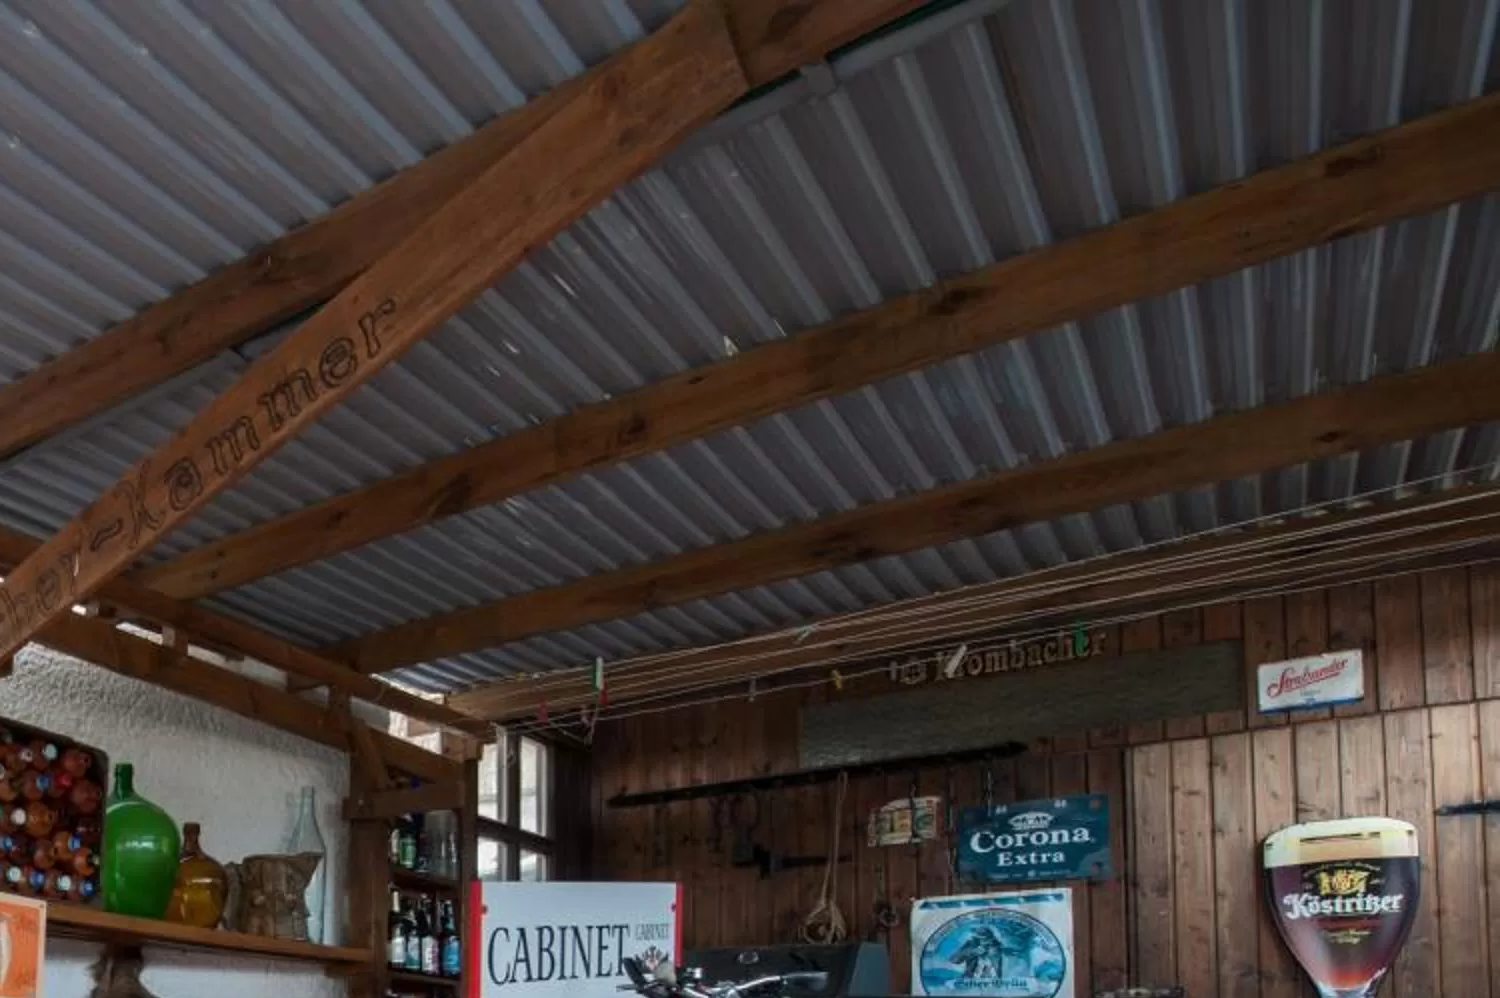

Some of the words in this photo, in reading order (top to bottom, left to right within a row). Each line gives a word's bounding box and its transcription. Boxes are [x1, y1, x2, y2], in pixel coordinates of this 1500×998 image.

[969, 826, 1092, 854] Corona
[996, 850, 1067, 868] Extra
[487, 924, 629, 985] CABINET
